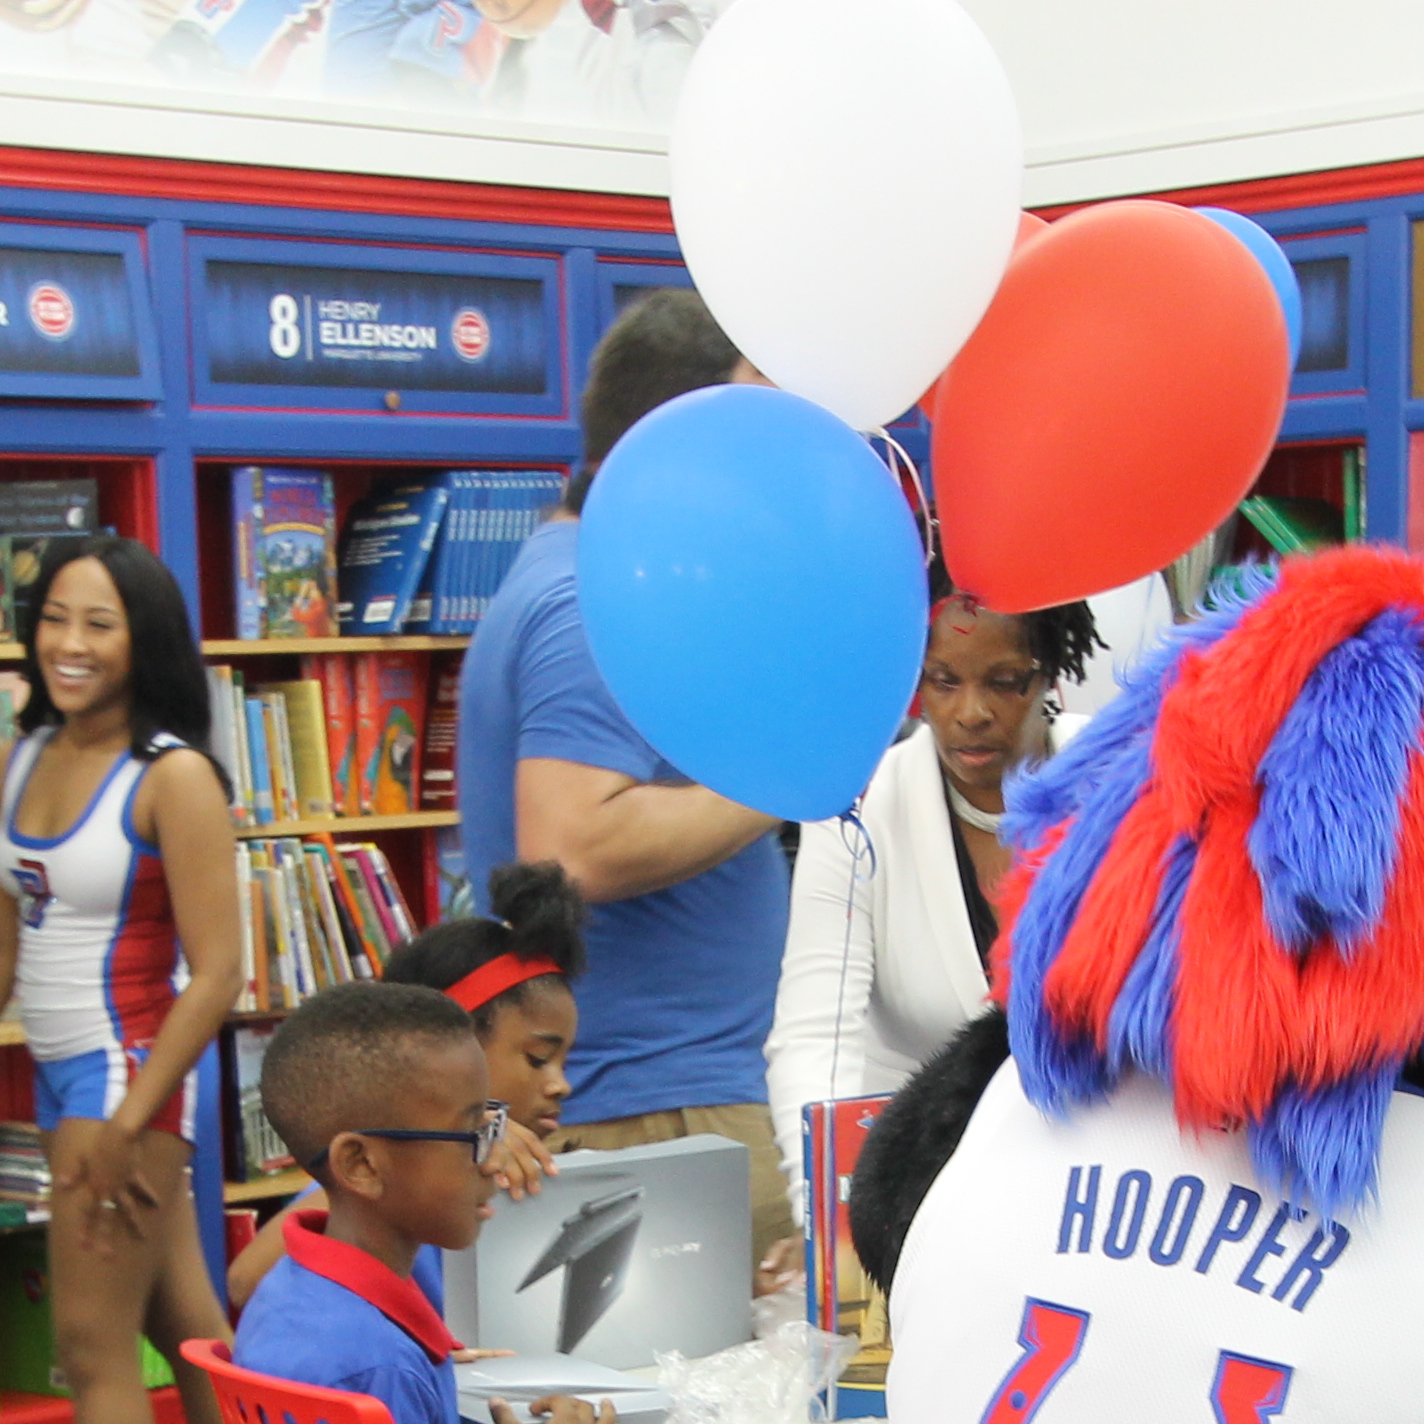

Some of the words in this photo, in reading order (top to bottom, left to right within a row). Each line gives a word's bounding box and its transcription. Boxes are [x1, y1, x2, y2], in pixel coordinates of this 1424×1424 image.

[269, 293, 301, 360] 8
[318, 300, 381, 321] HENRY
[320, 321, 437, 349] ELLENSON
[1055, 1164, 1350, 1313] HOOPER
